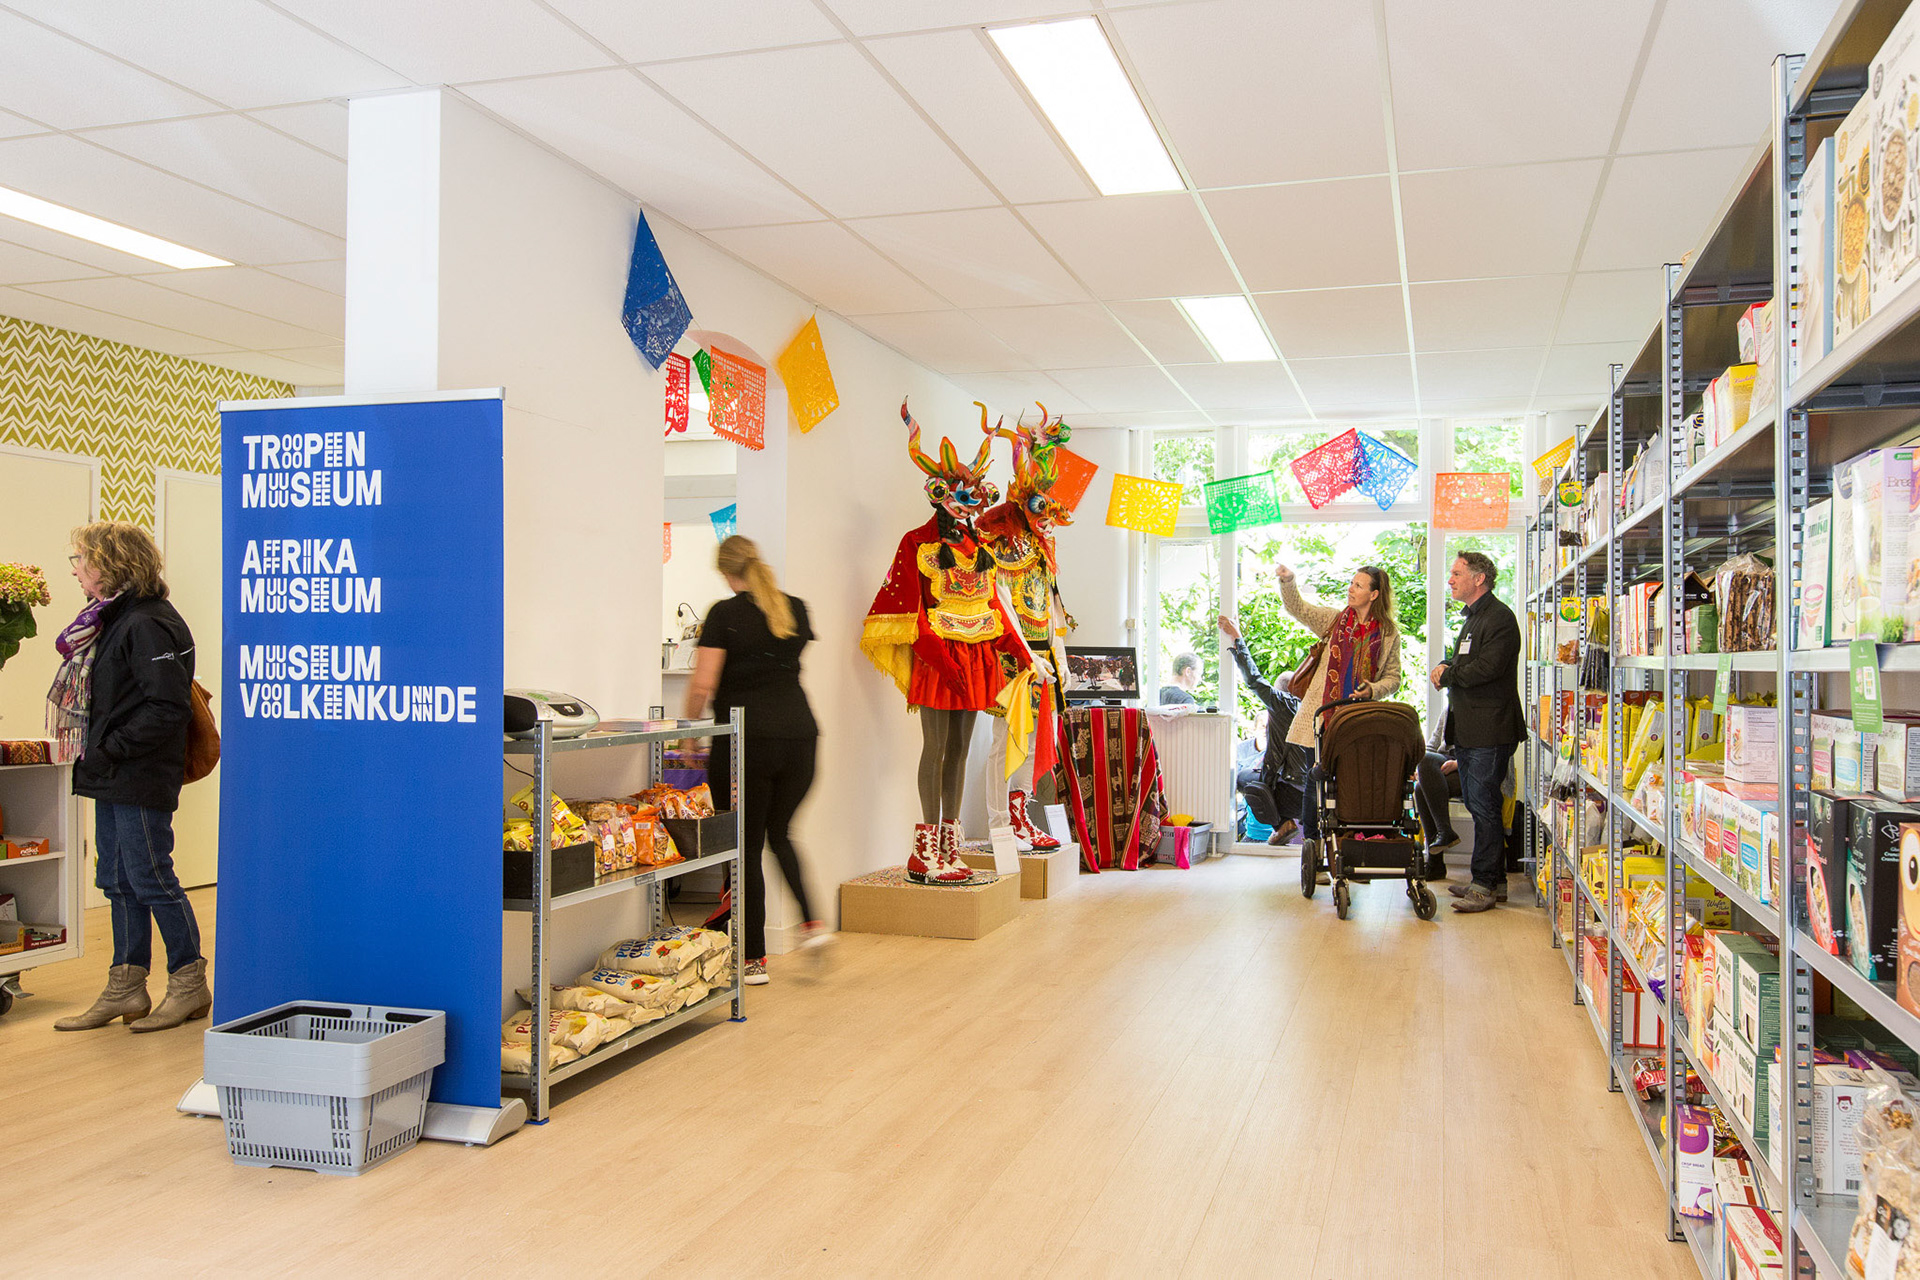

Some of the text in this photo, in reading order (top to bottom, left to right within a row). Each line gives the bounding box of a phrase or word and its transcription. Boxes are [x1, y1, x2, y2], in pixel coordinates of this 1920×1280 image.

[242, 469, 382, 508] MUSEUM
[240, 577, 382, 614] MUSEUM
[239, 644, 381, 682] MUSEUM
